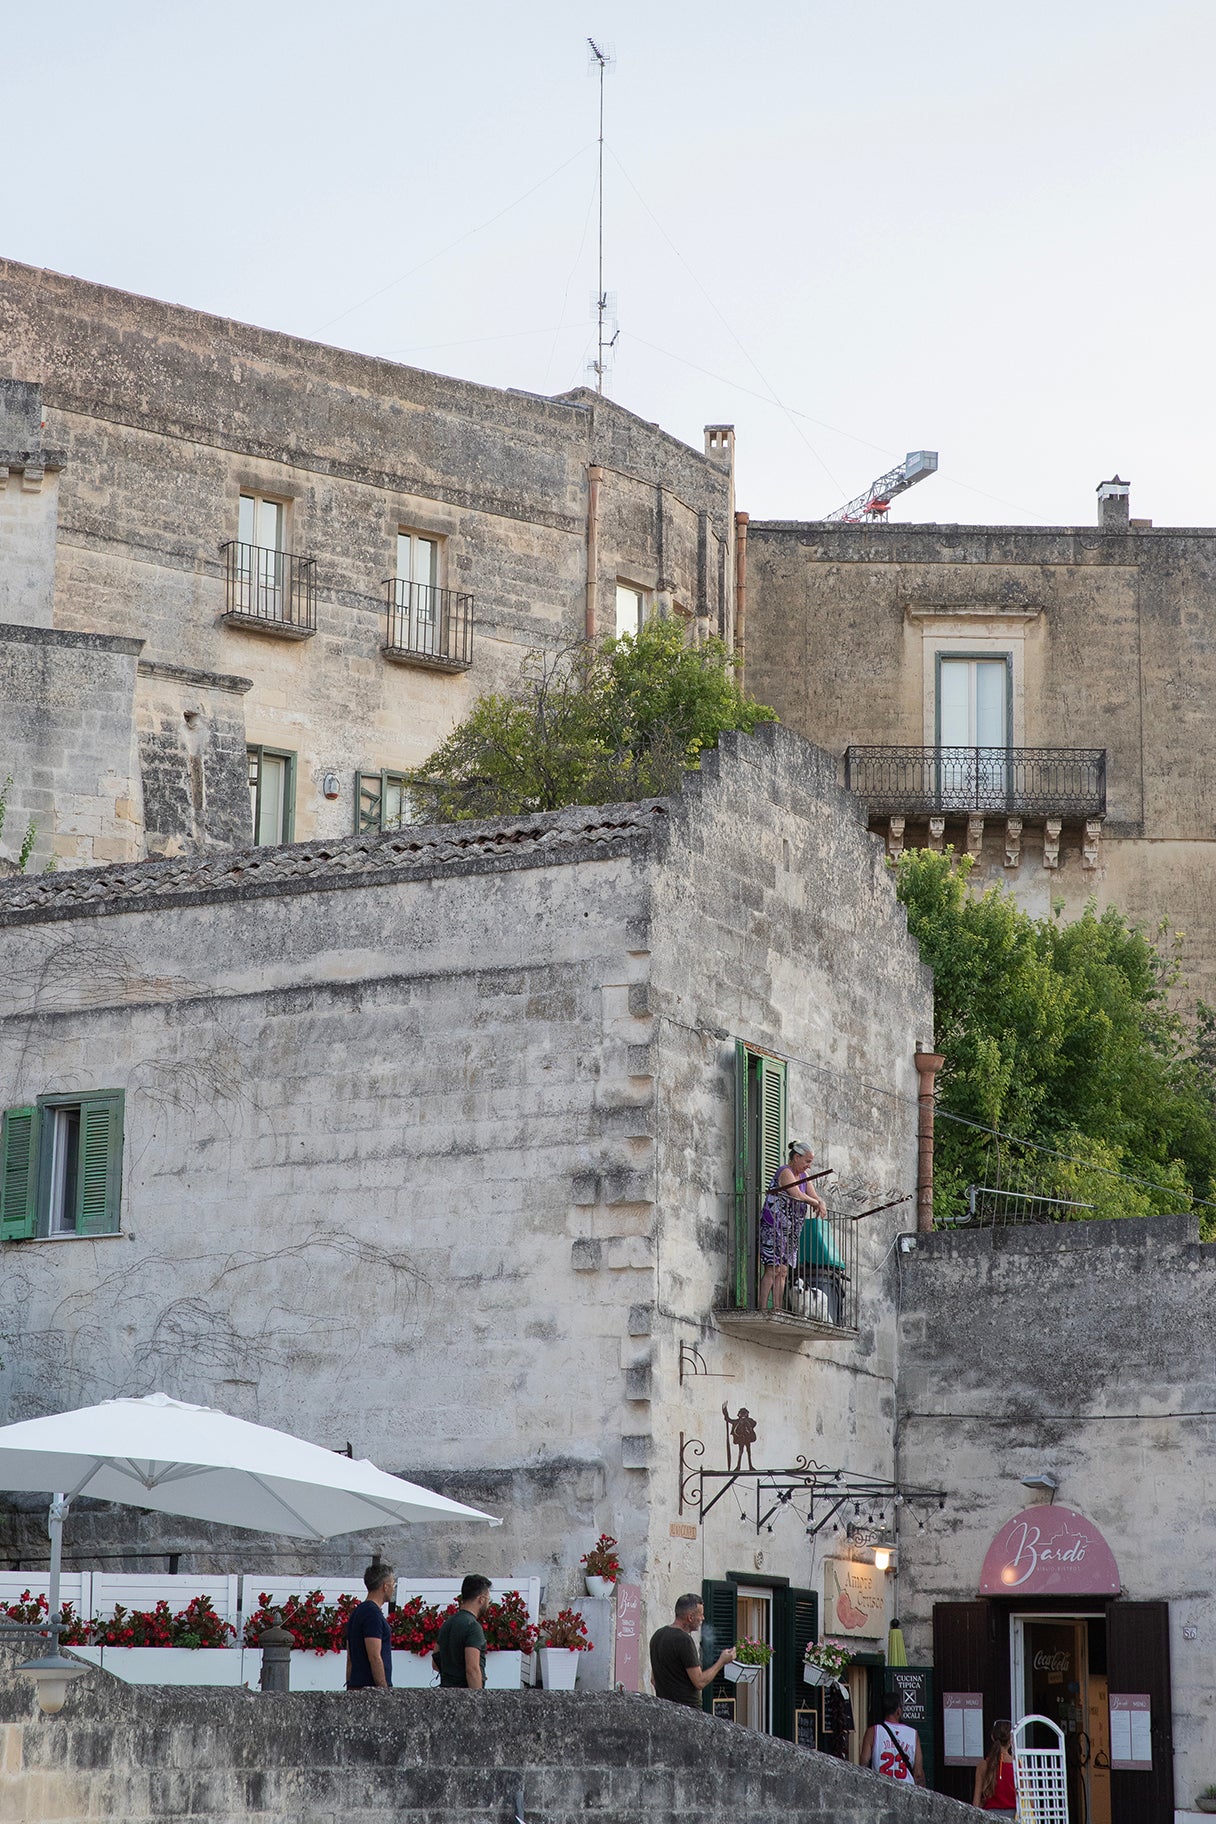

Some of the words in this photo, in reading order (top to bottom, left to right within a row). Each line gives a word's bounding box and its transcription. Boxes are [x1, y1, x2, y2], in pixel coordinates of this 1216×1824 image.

[1001, 1522, 1088, 1586] Bardó
[845, 1572, 872, 1589] Amore
[879, 1751, 908, 1779] 23
